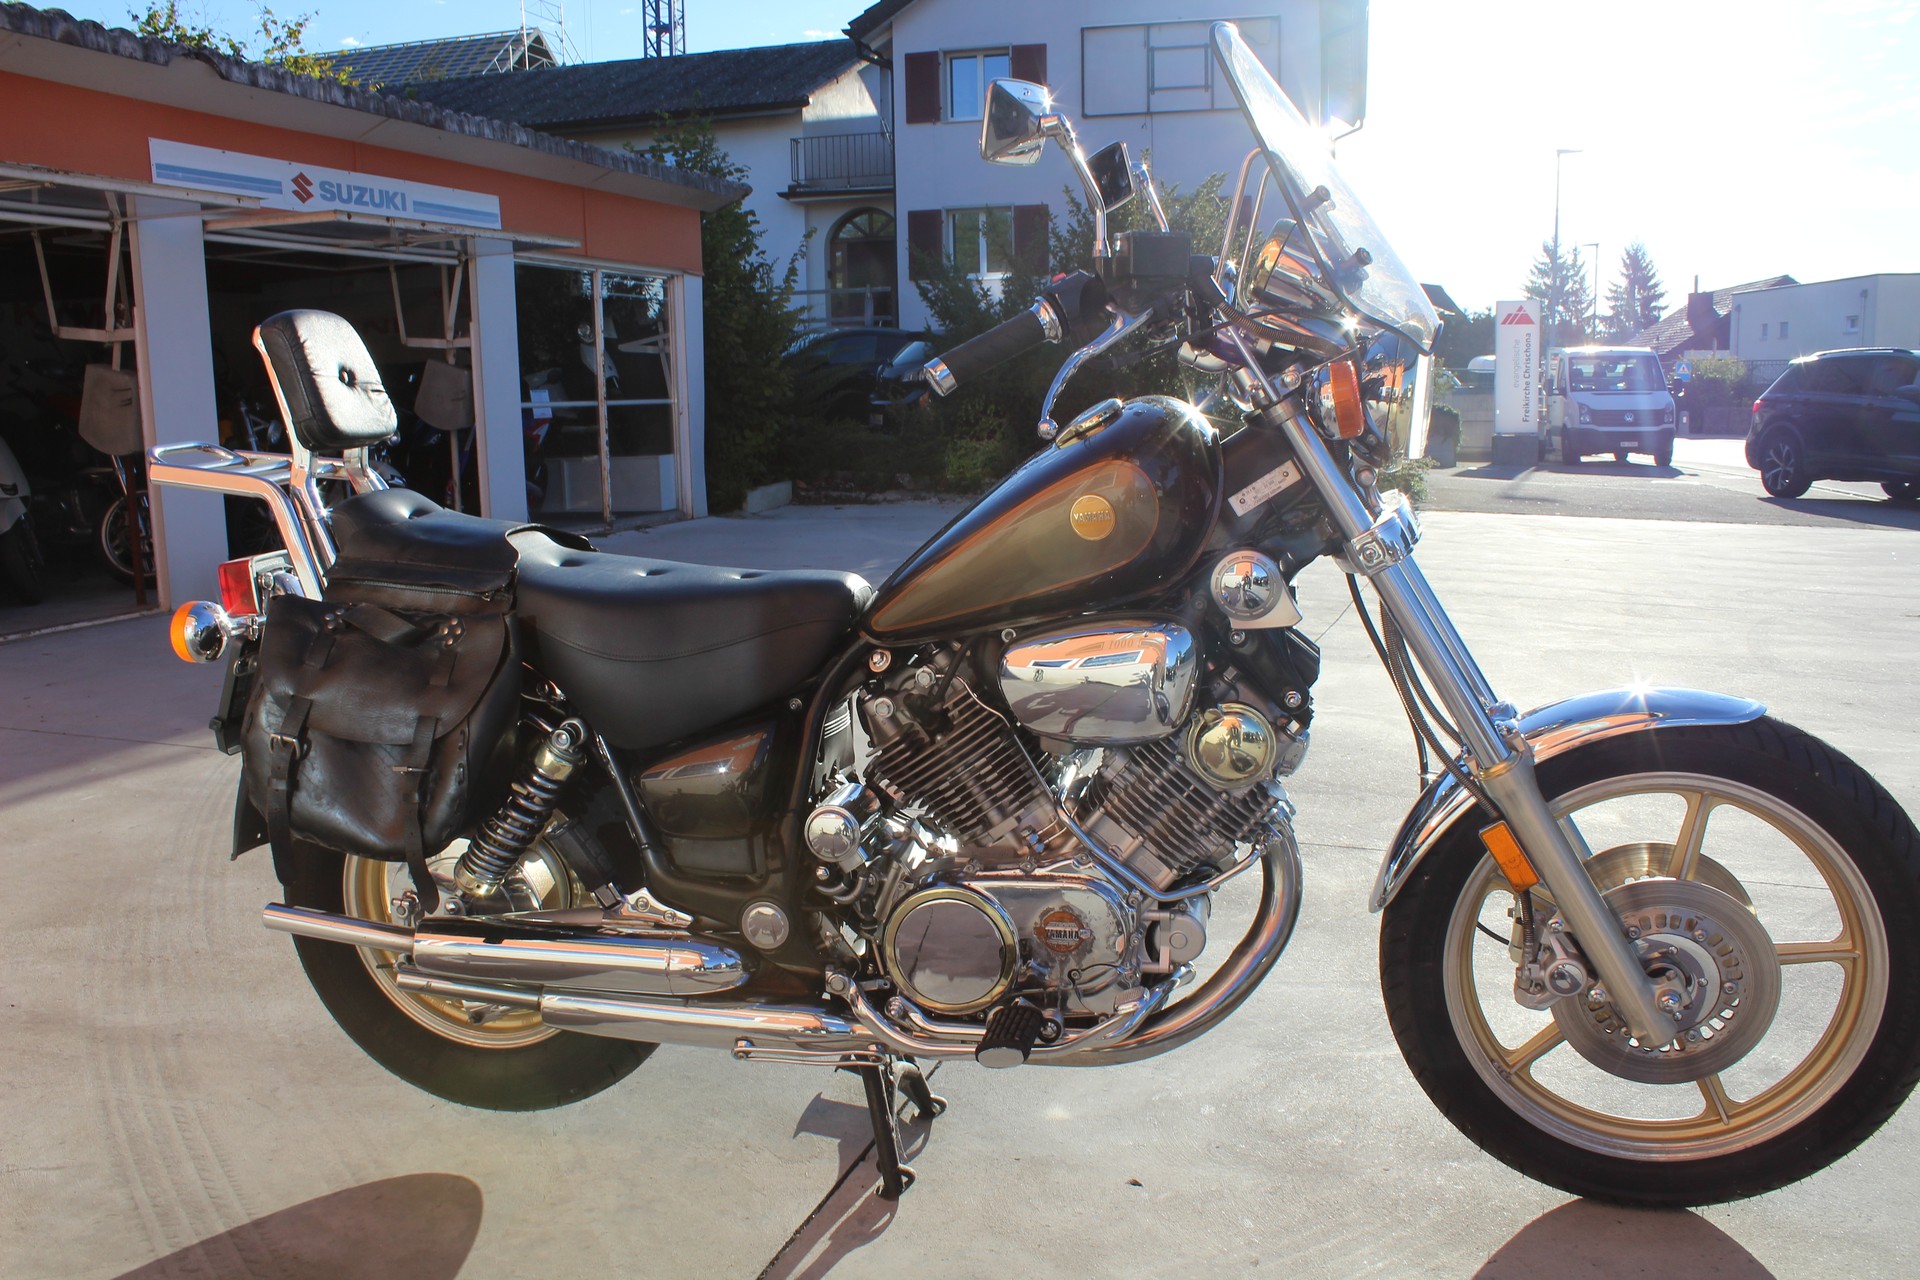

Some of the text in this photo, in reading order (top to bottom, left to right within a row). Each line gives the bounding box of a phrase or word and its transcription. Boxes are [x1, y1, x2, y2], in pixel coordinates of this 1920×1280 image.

[319, 180, 407, 212] SUZUKI
[1522, 332, 1532, 423] Freikirche Chrischona
[1046, 929, 1080, 941] YAMAHA
